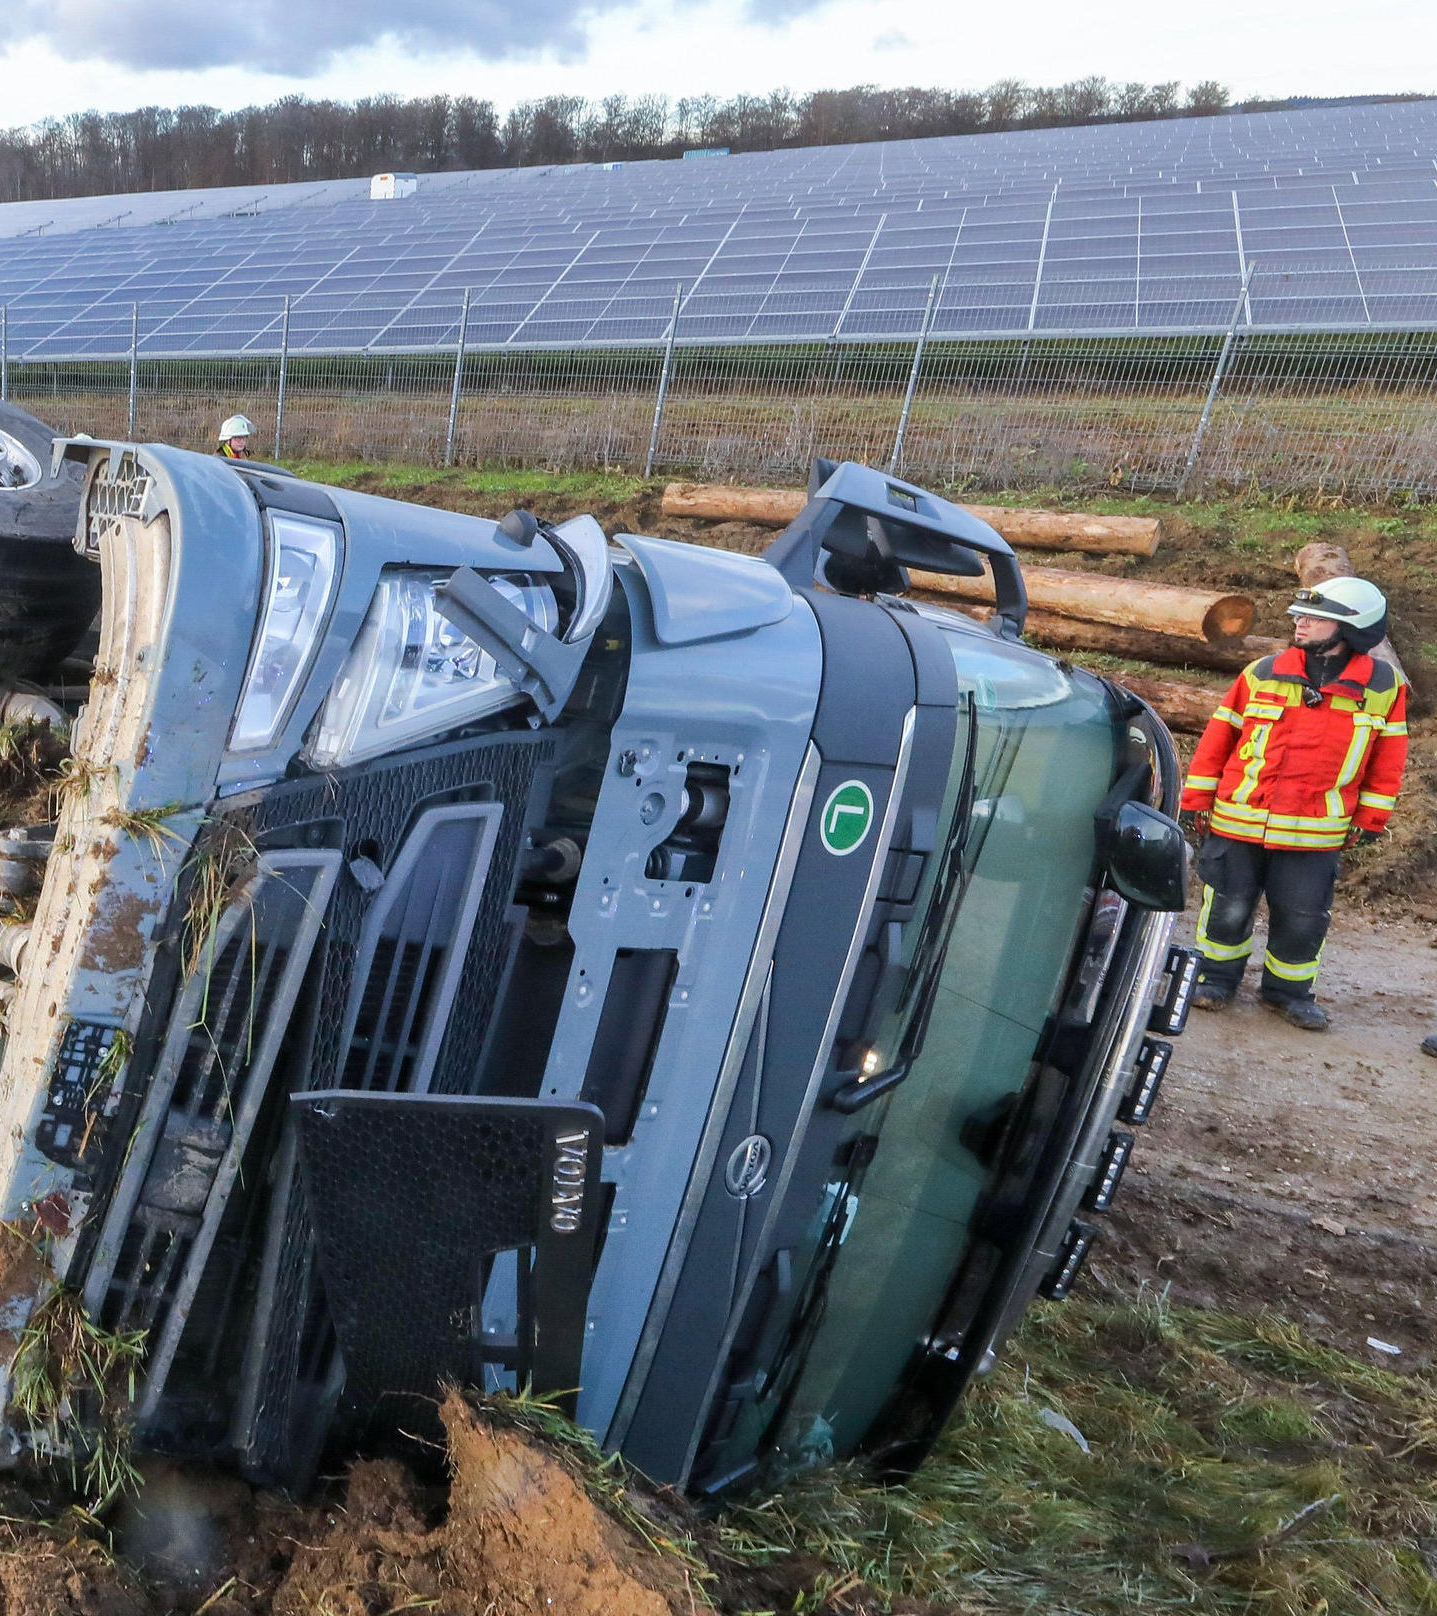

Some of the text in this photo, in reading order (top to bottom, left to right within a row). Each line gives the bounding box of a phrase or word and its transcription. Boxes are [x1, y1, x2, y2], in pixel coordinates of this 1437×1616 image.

[829, 804, 864, 834] L
[550, 1130, 590, 1233] VOLVO
[738, 1140, 761, 1192] VOLVO
